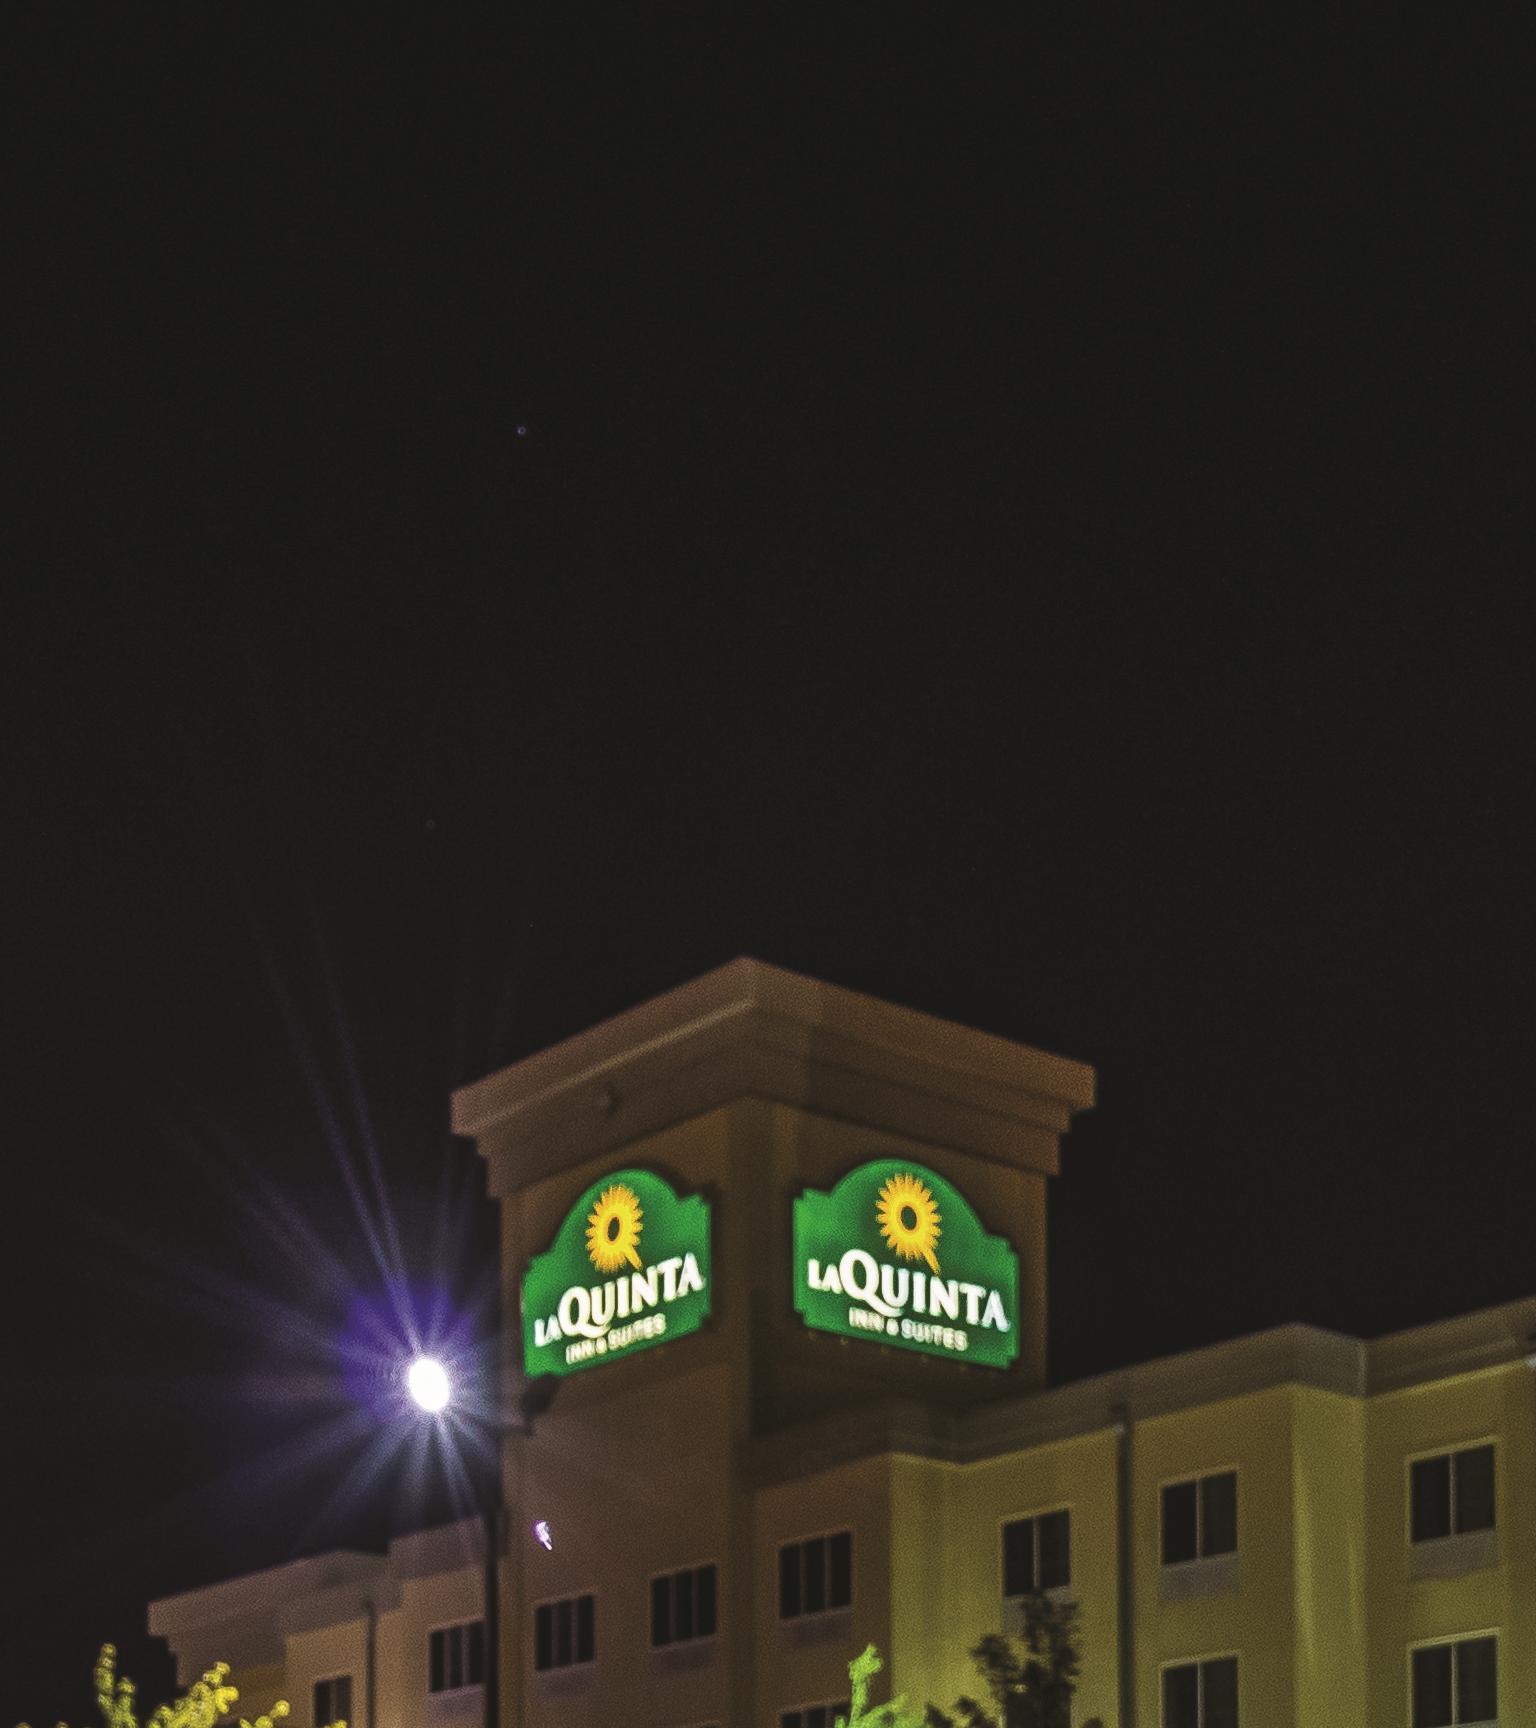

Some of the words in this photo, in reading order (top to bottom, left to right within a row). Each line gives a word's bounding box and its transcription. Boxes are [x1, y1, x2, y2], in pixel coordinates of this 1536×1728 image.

[565, 1339, 595, 1365] INN
[607, 1313, 667, 1351] SUITES
[848, 1307, 885, 1333] INN
[900, 1318, 968, 1352] SUITES
